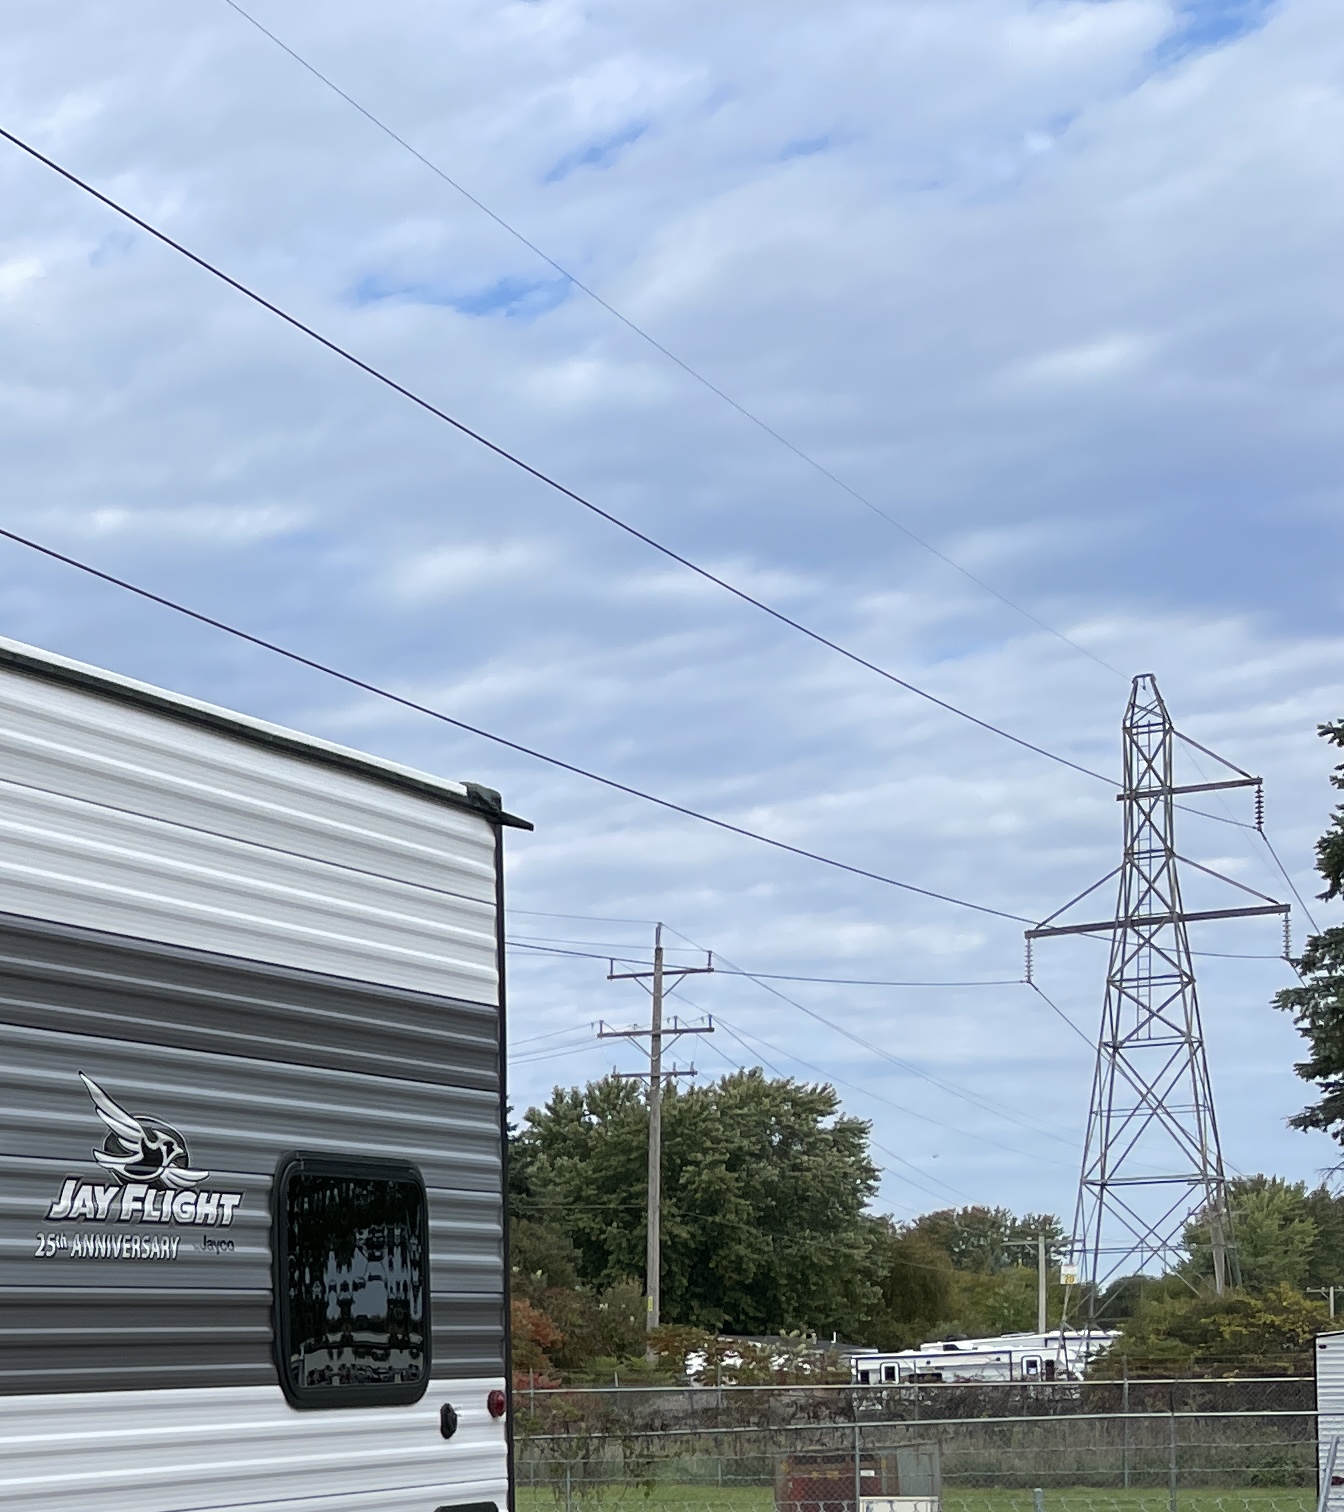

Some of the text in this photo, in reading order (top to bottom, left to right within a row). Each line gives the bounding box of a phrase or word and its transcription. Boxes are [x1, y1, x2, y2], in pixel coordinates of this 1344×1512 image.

[46, 1176, 244, 1226] JAY FLIGHT
[34, 1232, 180, 1260] 25th ANNIVERSARY
[200, 1234, 235, 1255] Jayco
